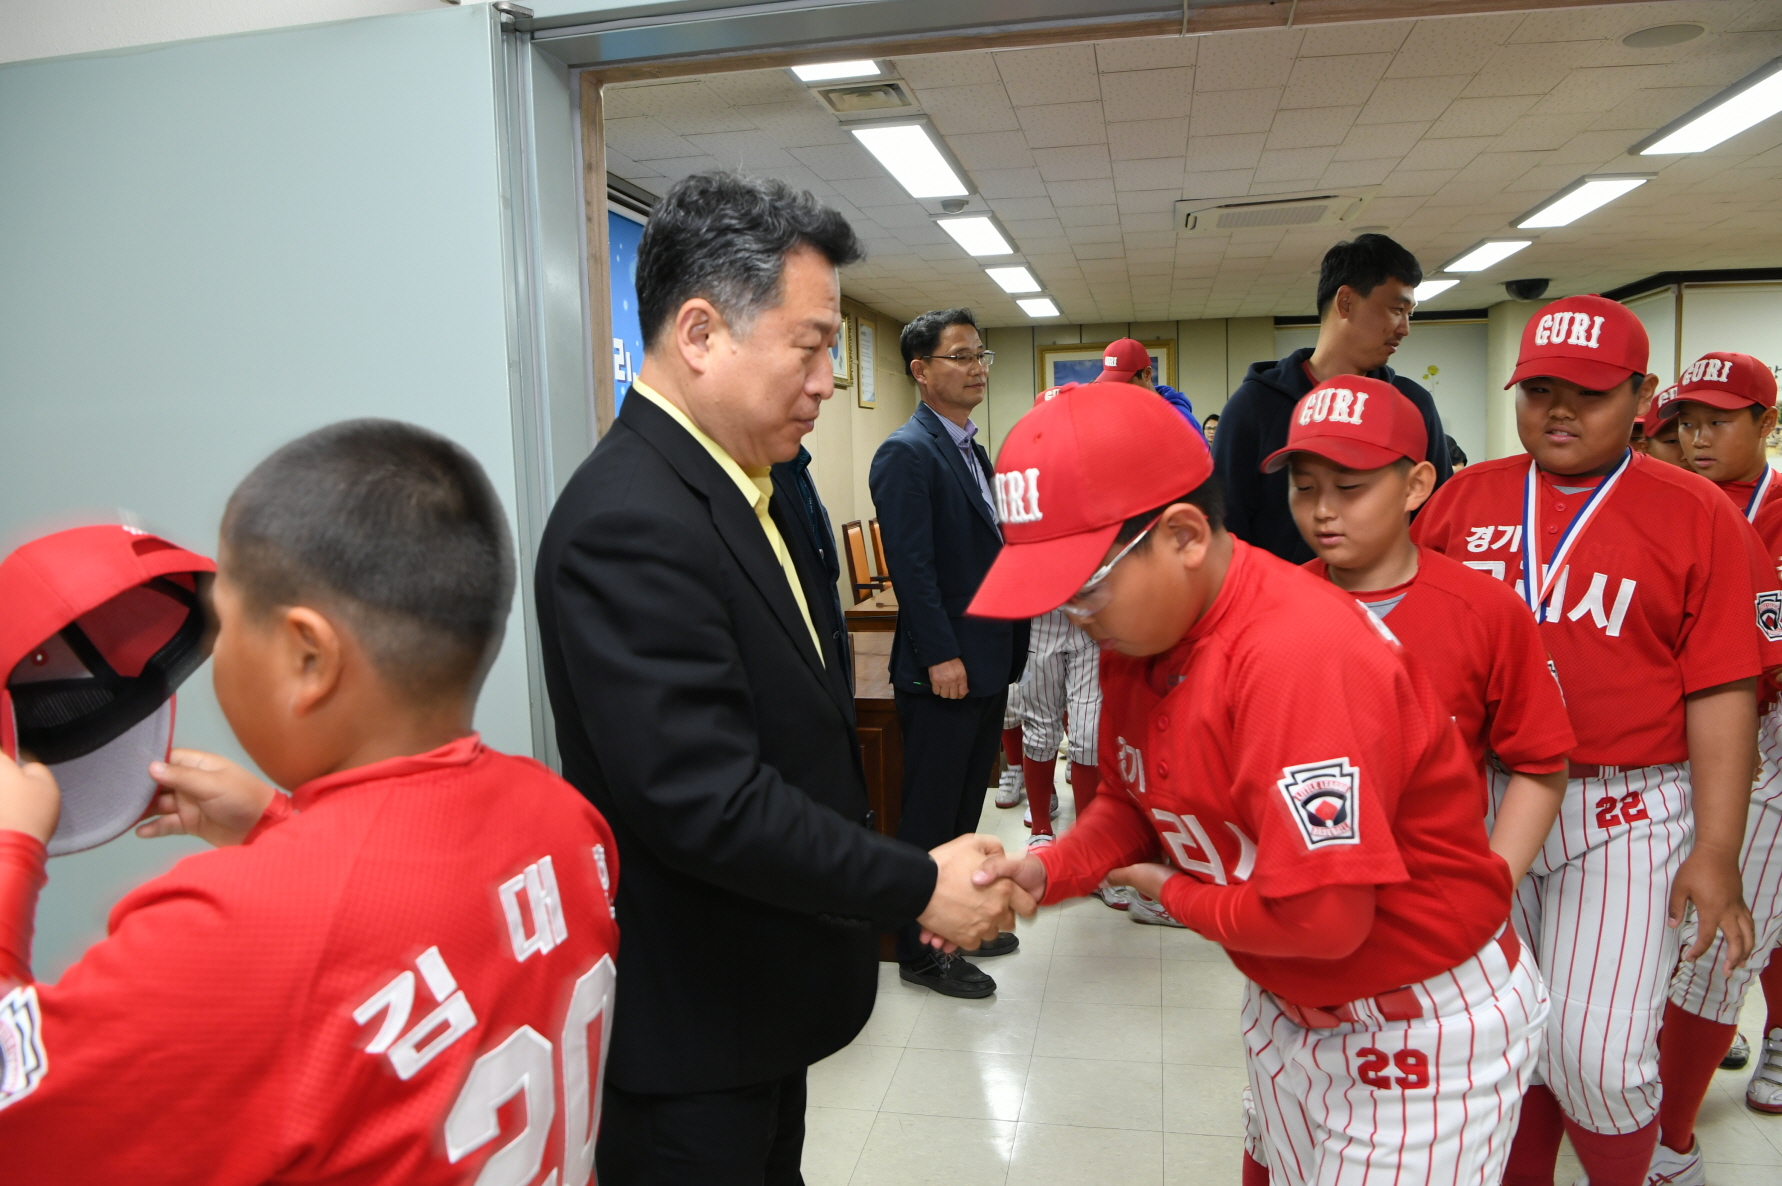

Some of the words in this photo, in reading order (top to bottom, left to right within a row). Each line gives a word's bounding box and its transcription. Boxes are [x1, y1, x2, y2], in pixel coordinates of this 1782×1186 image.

[1535, 312, 1605, 349] GURI
[1682, 359, 1733, 386] GURI
[1299, 388, 1369, 426] GURI
[994, 467, 1043, 523] URI
[1465, 525, 1522, 553] 경기
[1595, 790, 1649, 829] 22
[1355, 1046, 1430, 1091] 29
